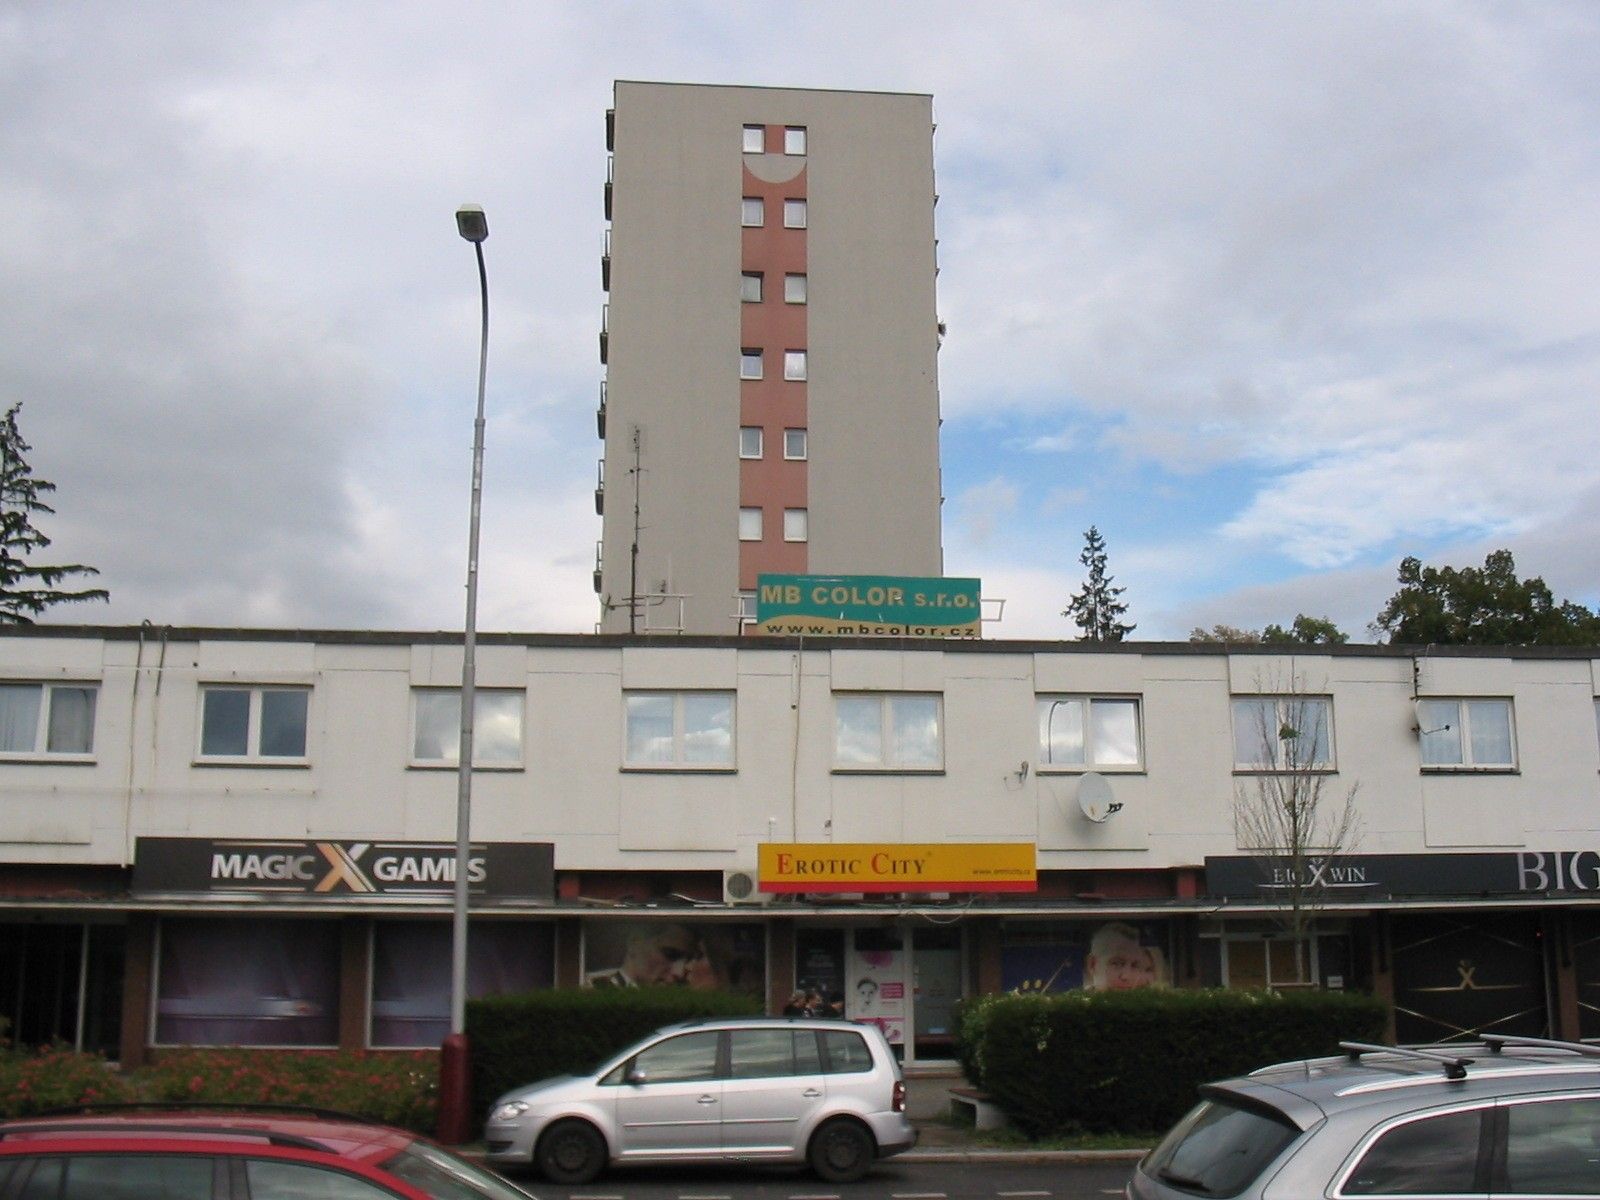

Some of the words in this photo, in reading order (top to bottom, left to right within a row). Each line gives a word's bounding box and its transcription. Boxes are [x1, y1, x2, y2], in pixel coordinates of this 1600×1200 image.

[761, 585, 801, 604] MB
[812, 586, 904, 606] COLOR
[914, 592, 976, 608] s.r.o.
[766, 624, 976, 636] www.mbcolor.cz
[211, 854, 316, 880] MAGIC
[776, 853, 861, 875] EROTIC
[871, 853, 926, 875] CITY
[1330, 867, 1366, 882] WIN
